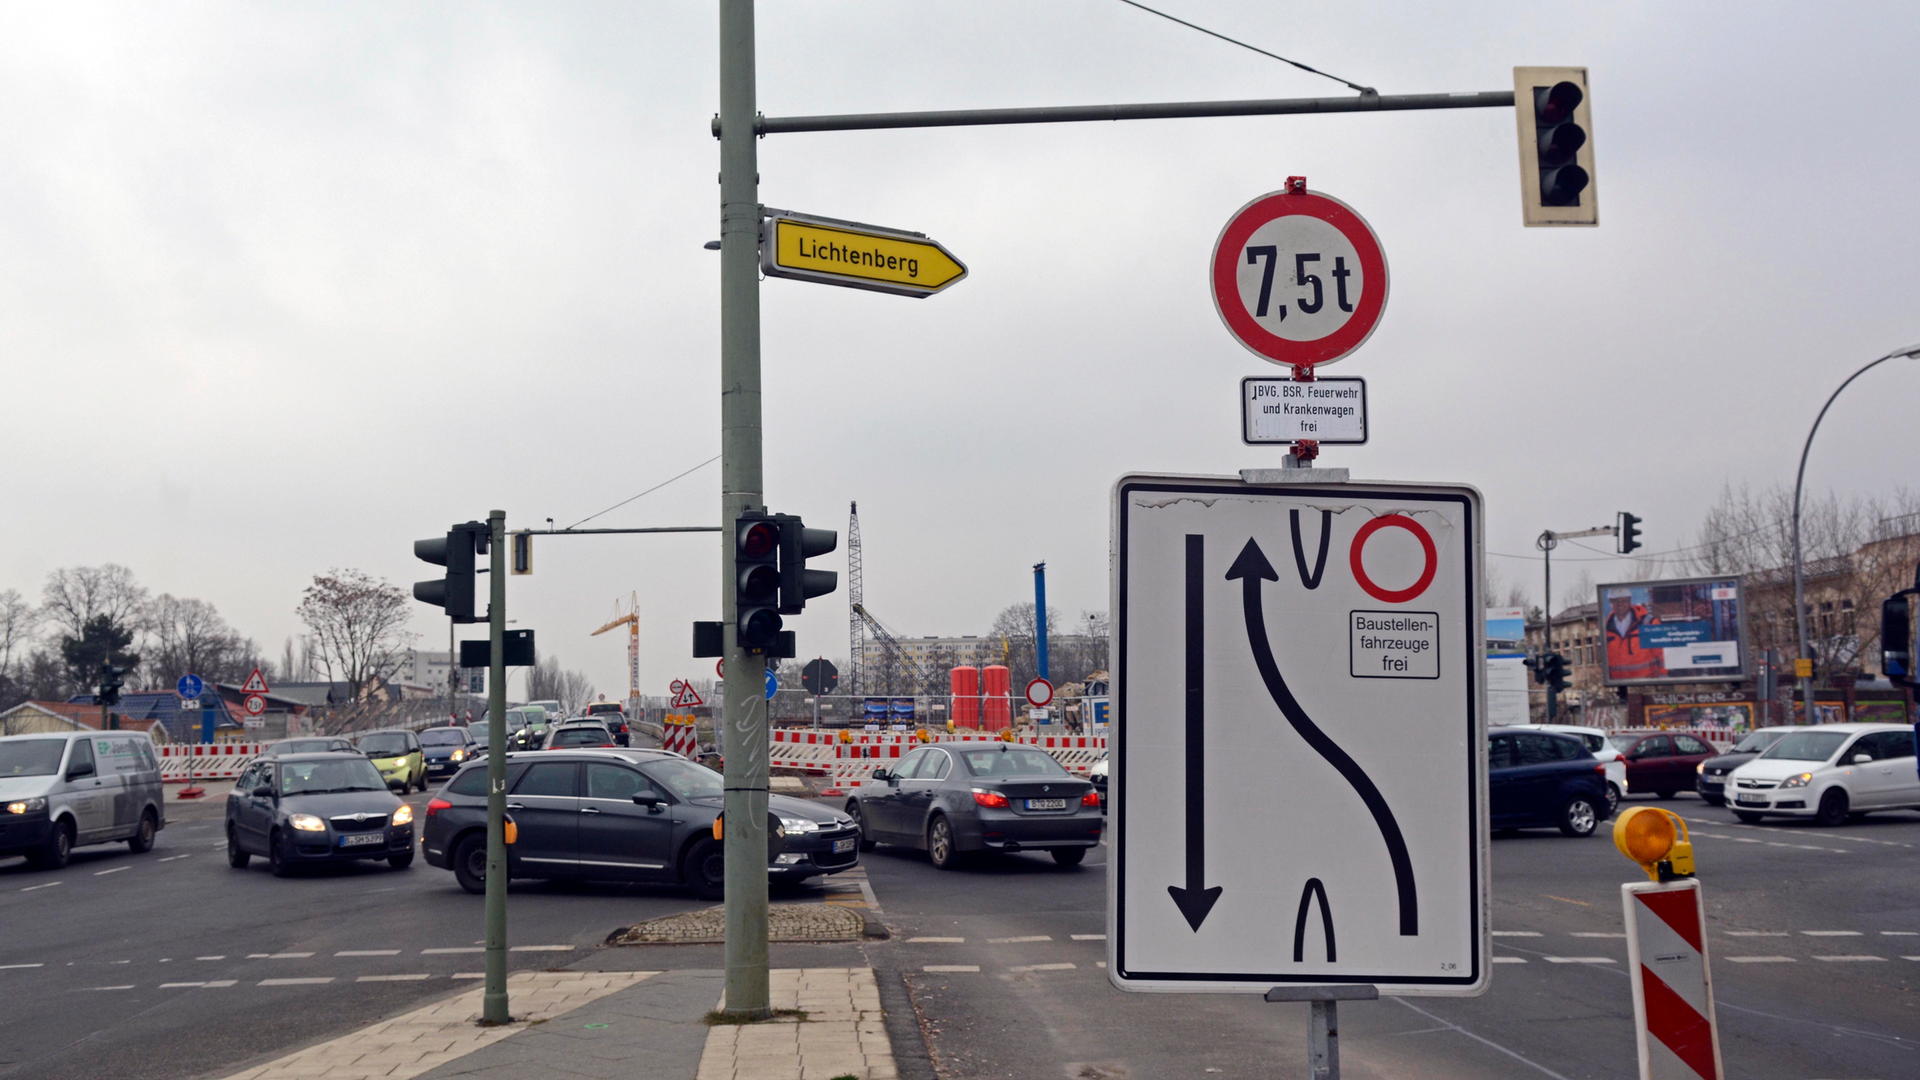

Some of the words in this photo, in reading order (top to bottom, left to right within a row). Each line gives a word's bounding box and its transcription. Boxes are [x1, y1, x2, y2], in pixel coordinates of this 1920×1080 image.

[799, 237, 918, 278] Lichtenberg
[1308, 386, 1359, 399] Feuerwehr
[1263, 403, 1280, 414] und
[1283, 403, 1354, 418] Krankenwagen
[1300, 420, 1317, 432] frei
[1356, 616, 1433, 632] Baustellen-
[1360, 635, 1429, 653] fahrzeuge
[1382, 655, 1408, 671] frei
